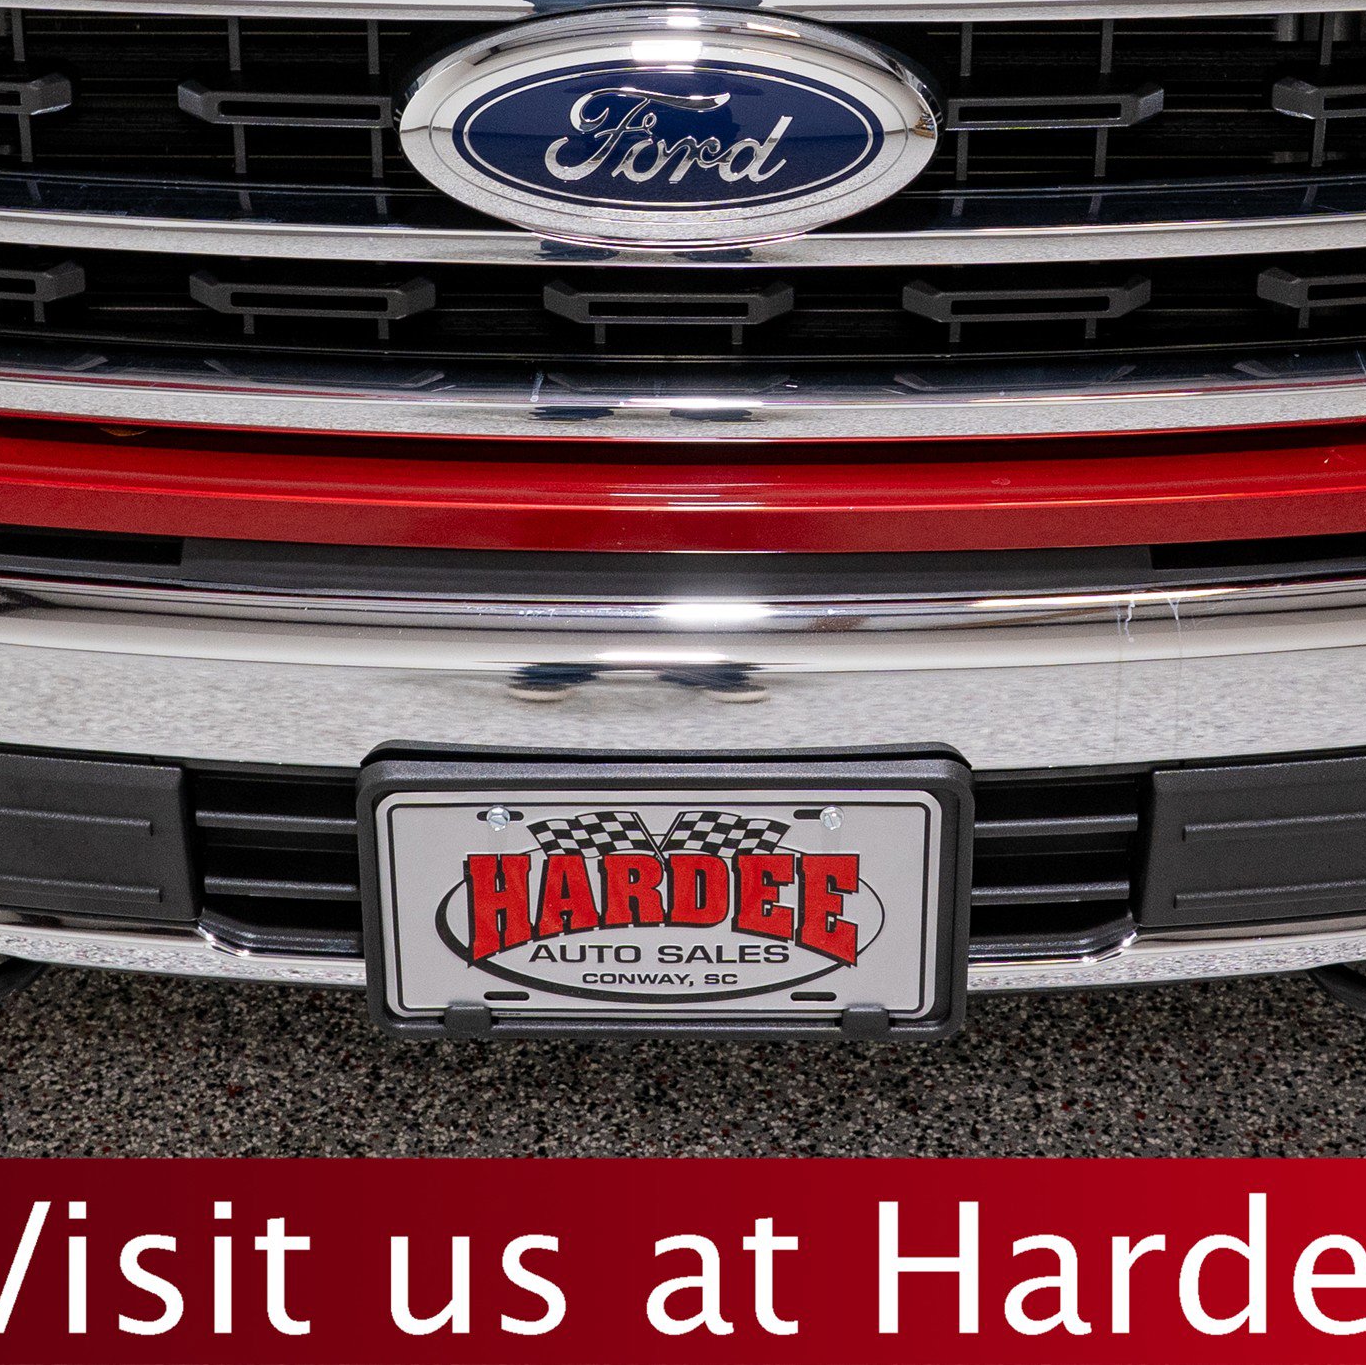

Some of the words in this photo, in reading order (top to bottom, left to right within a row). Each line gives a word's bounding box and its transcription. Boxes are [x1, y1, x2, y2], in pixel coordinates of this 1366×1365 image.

[544, 86, 794, 183] Ford
[463, 853, 860, 968] HARDEE
[528, 944, 642, 964] AUTO
[657, 944, 790, 964] SALES
[582, 972, 696, 986] CONWAY,
[703, 972, 739, 986] SC
